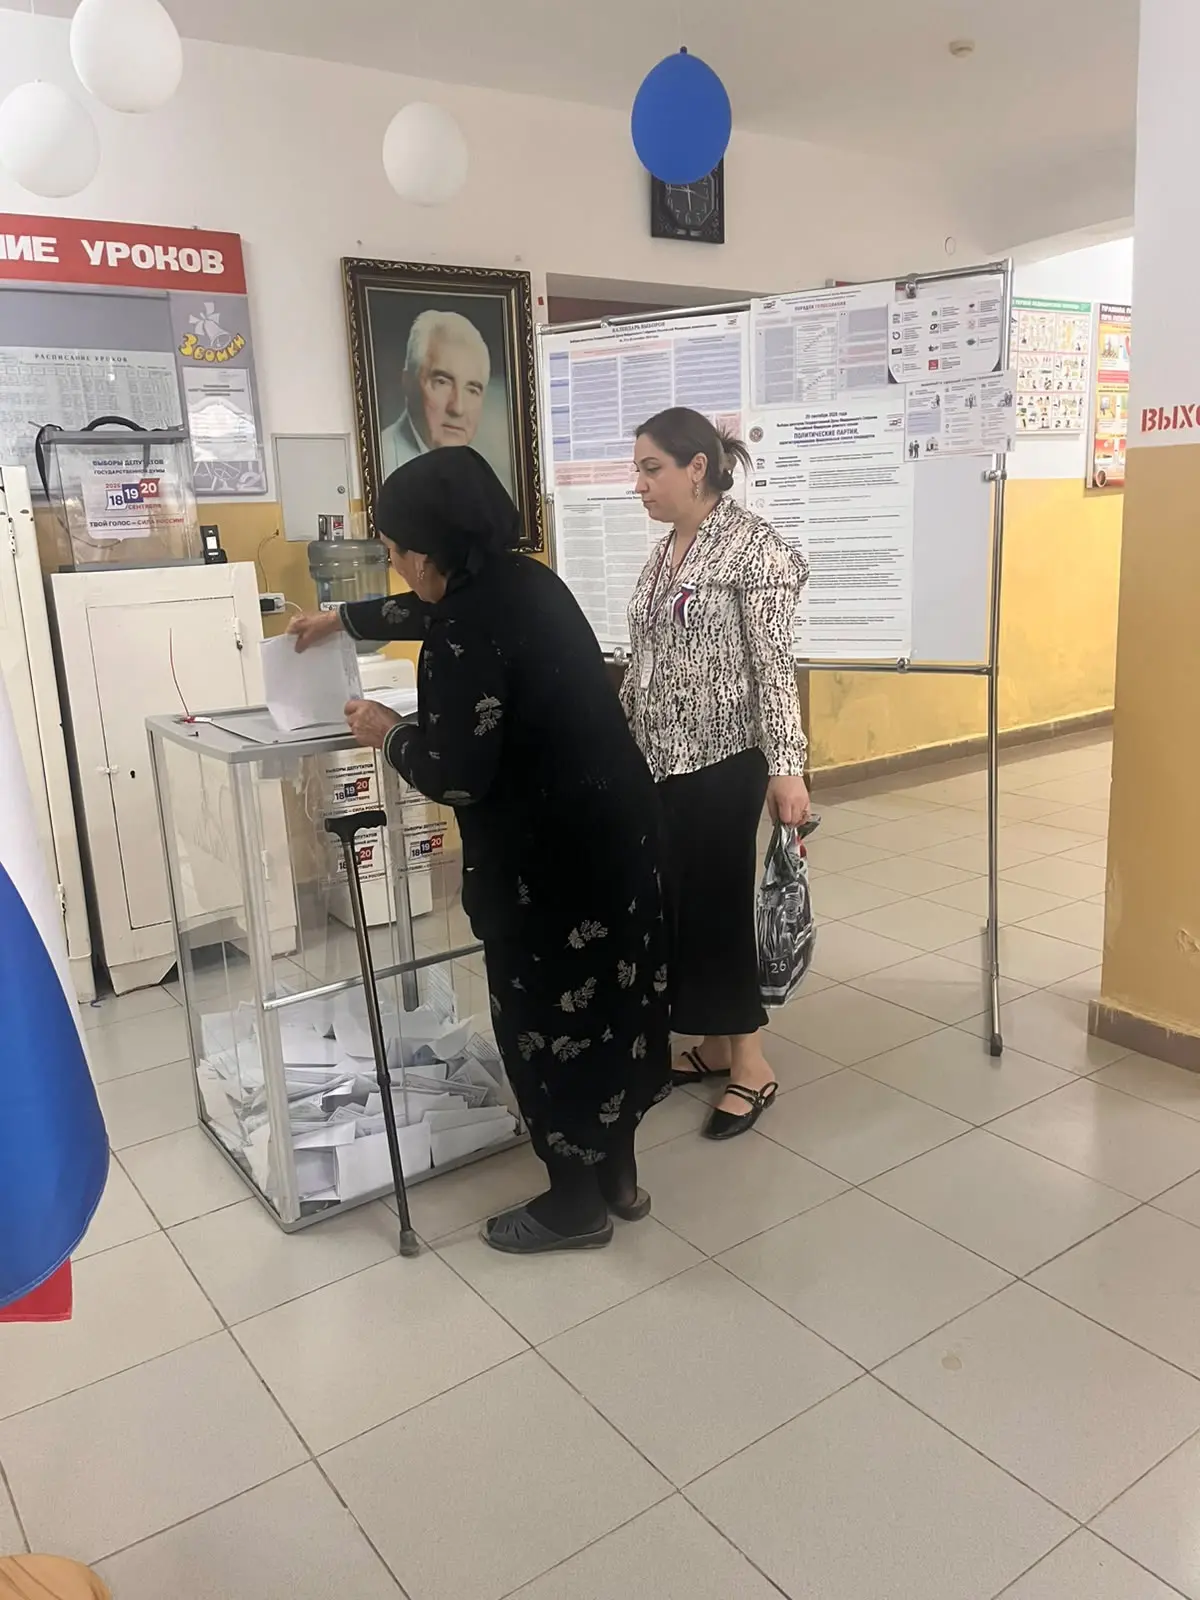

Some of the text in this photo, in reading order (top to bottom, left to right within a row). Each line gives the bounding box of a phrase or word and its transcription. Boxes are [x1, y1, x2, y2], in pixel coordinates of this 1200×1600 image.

[81, 239, 225, 274] УРОКОВ
[34, 353, 128, 363] РАСПИСАНИЕ УРОКОВ
[794, 430, 835, 439] ПОЛИТИЧЕСКИЕ
[109, 482, 157, 506] 18 19 20
[335, 791, 345, 800] 18
[346, 785, 356, 795] 19
[356, 780, 368, 790] 20
[360, 849, 372, 859] 20
[411, 848, 421, 858] 18
[421, 843, 431, 852] 19
[431, 838, 442, 847] 20
[770, 960, 787, 974] 26
